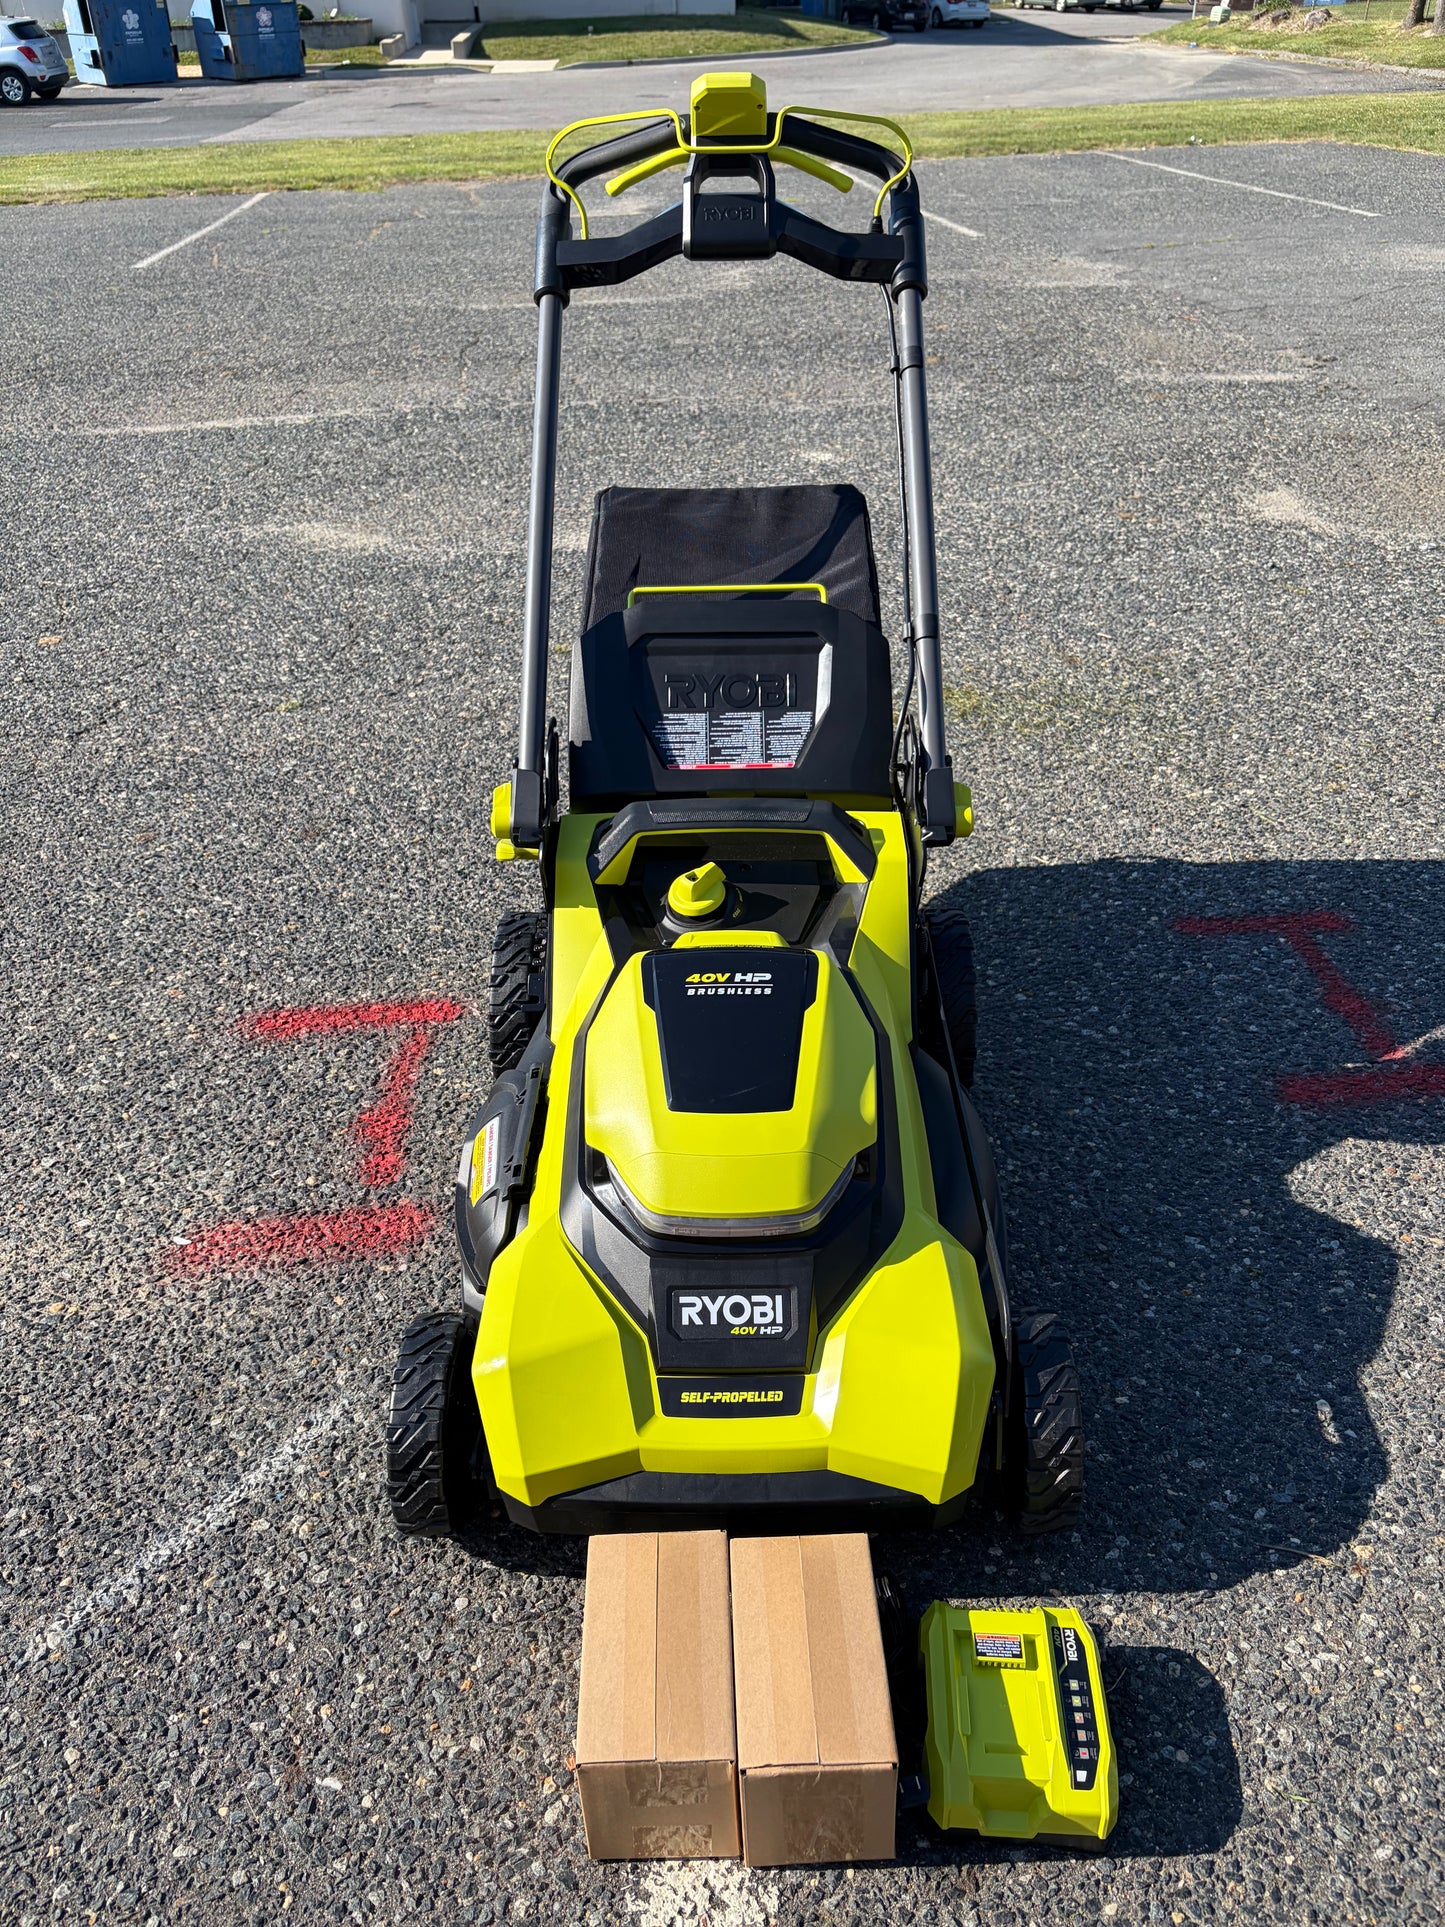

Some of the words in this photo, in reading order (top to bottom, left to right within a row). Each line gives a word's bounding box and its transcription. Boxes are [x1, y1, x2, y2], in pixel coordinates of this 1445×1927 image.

[703, 206, 755, 222] RYOBI
[665, 673, 797, 709] RYOBI
[685, 973, 731, 984] 40V
[734, 973, 772, 983] HP
[687, 988, 772, 997] BRUSHLESS
[679, 1294, 783, 1326] RYOBI
[730, 1326, 757, 1335] 40V
[759, 1326, 783, 1335] HP
[680, 1390, 784, 1403] SELF-PROPELLED
[1053, 1628, 1061, 1648] 40V
[1064, 1629, 1078, 1661] RYOBI
